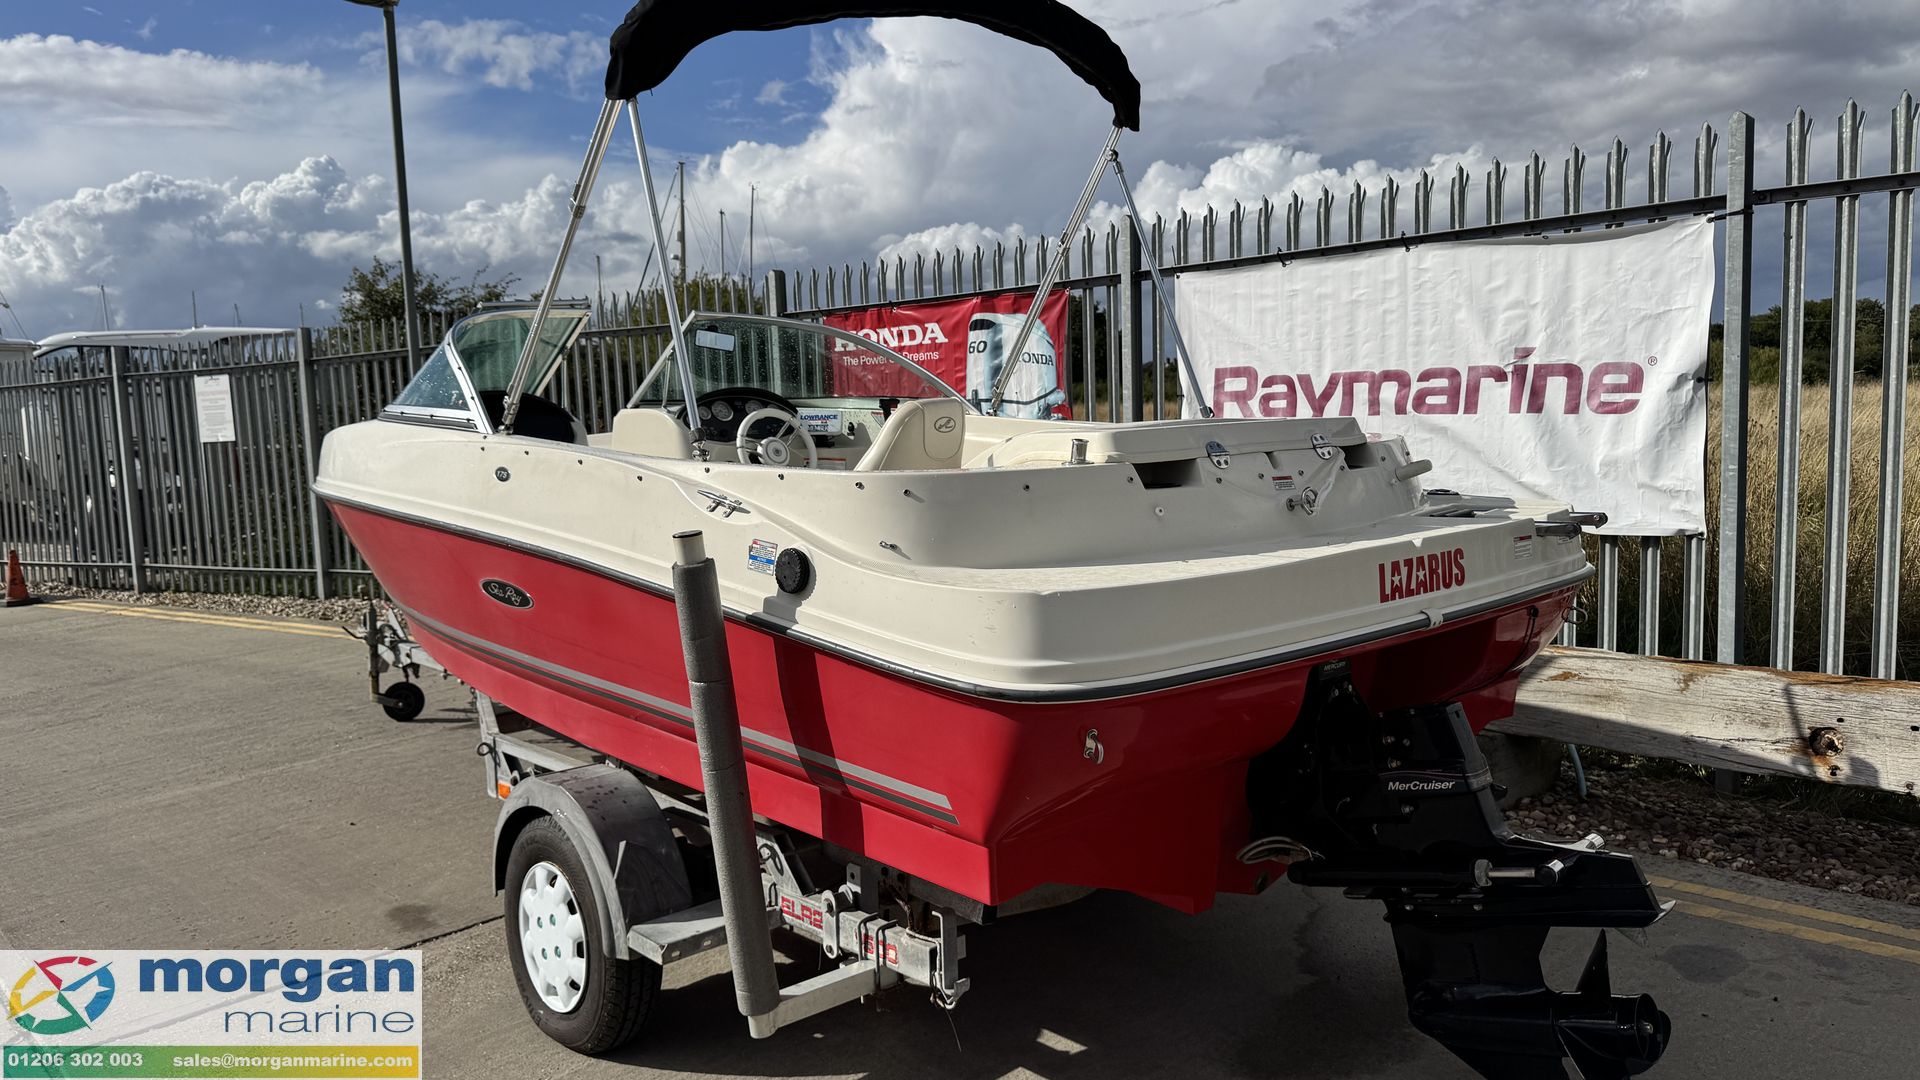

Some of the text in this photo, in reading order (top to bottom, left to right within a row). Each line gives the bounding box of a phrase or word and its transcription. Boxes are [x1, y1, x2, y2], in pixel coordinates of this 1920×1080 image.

[968, 340, 988, 354] 60
[843, 356, 859, 366] The
[1019, 351, 1055, 366] ONDA
[1378, 547, 1466, 604] LAZARUS
[488, 583, 522, 606] Sea Ray
[1387, 780, 1456, 791] MerCruiser
